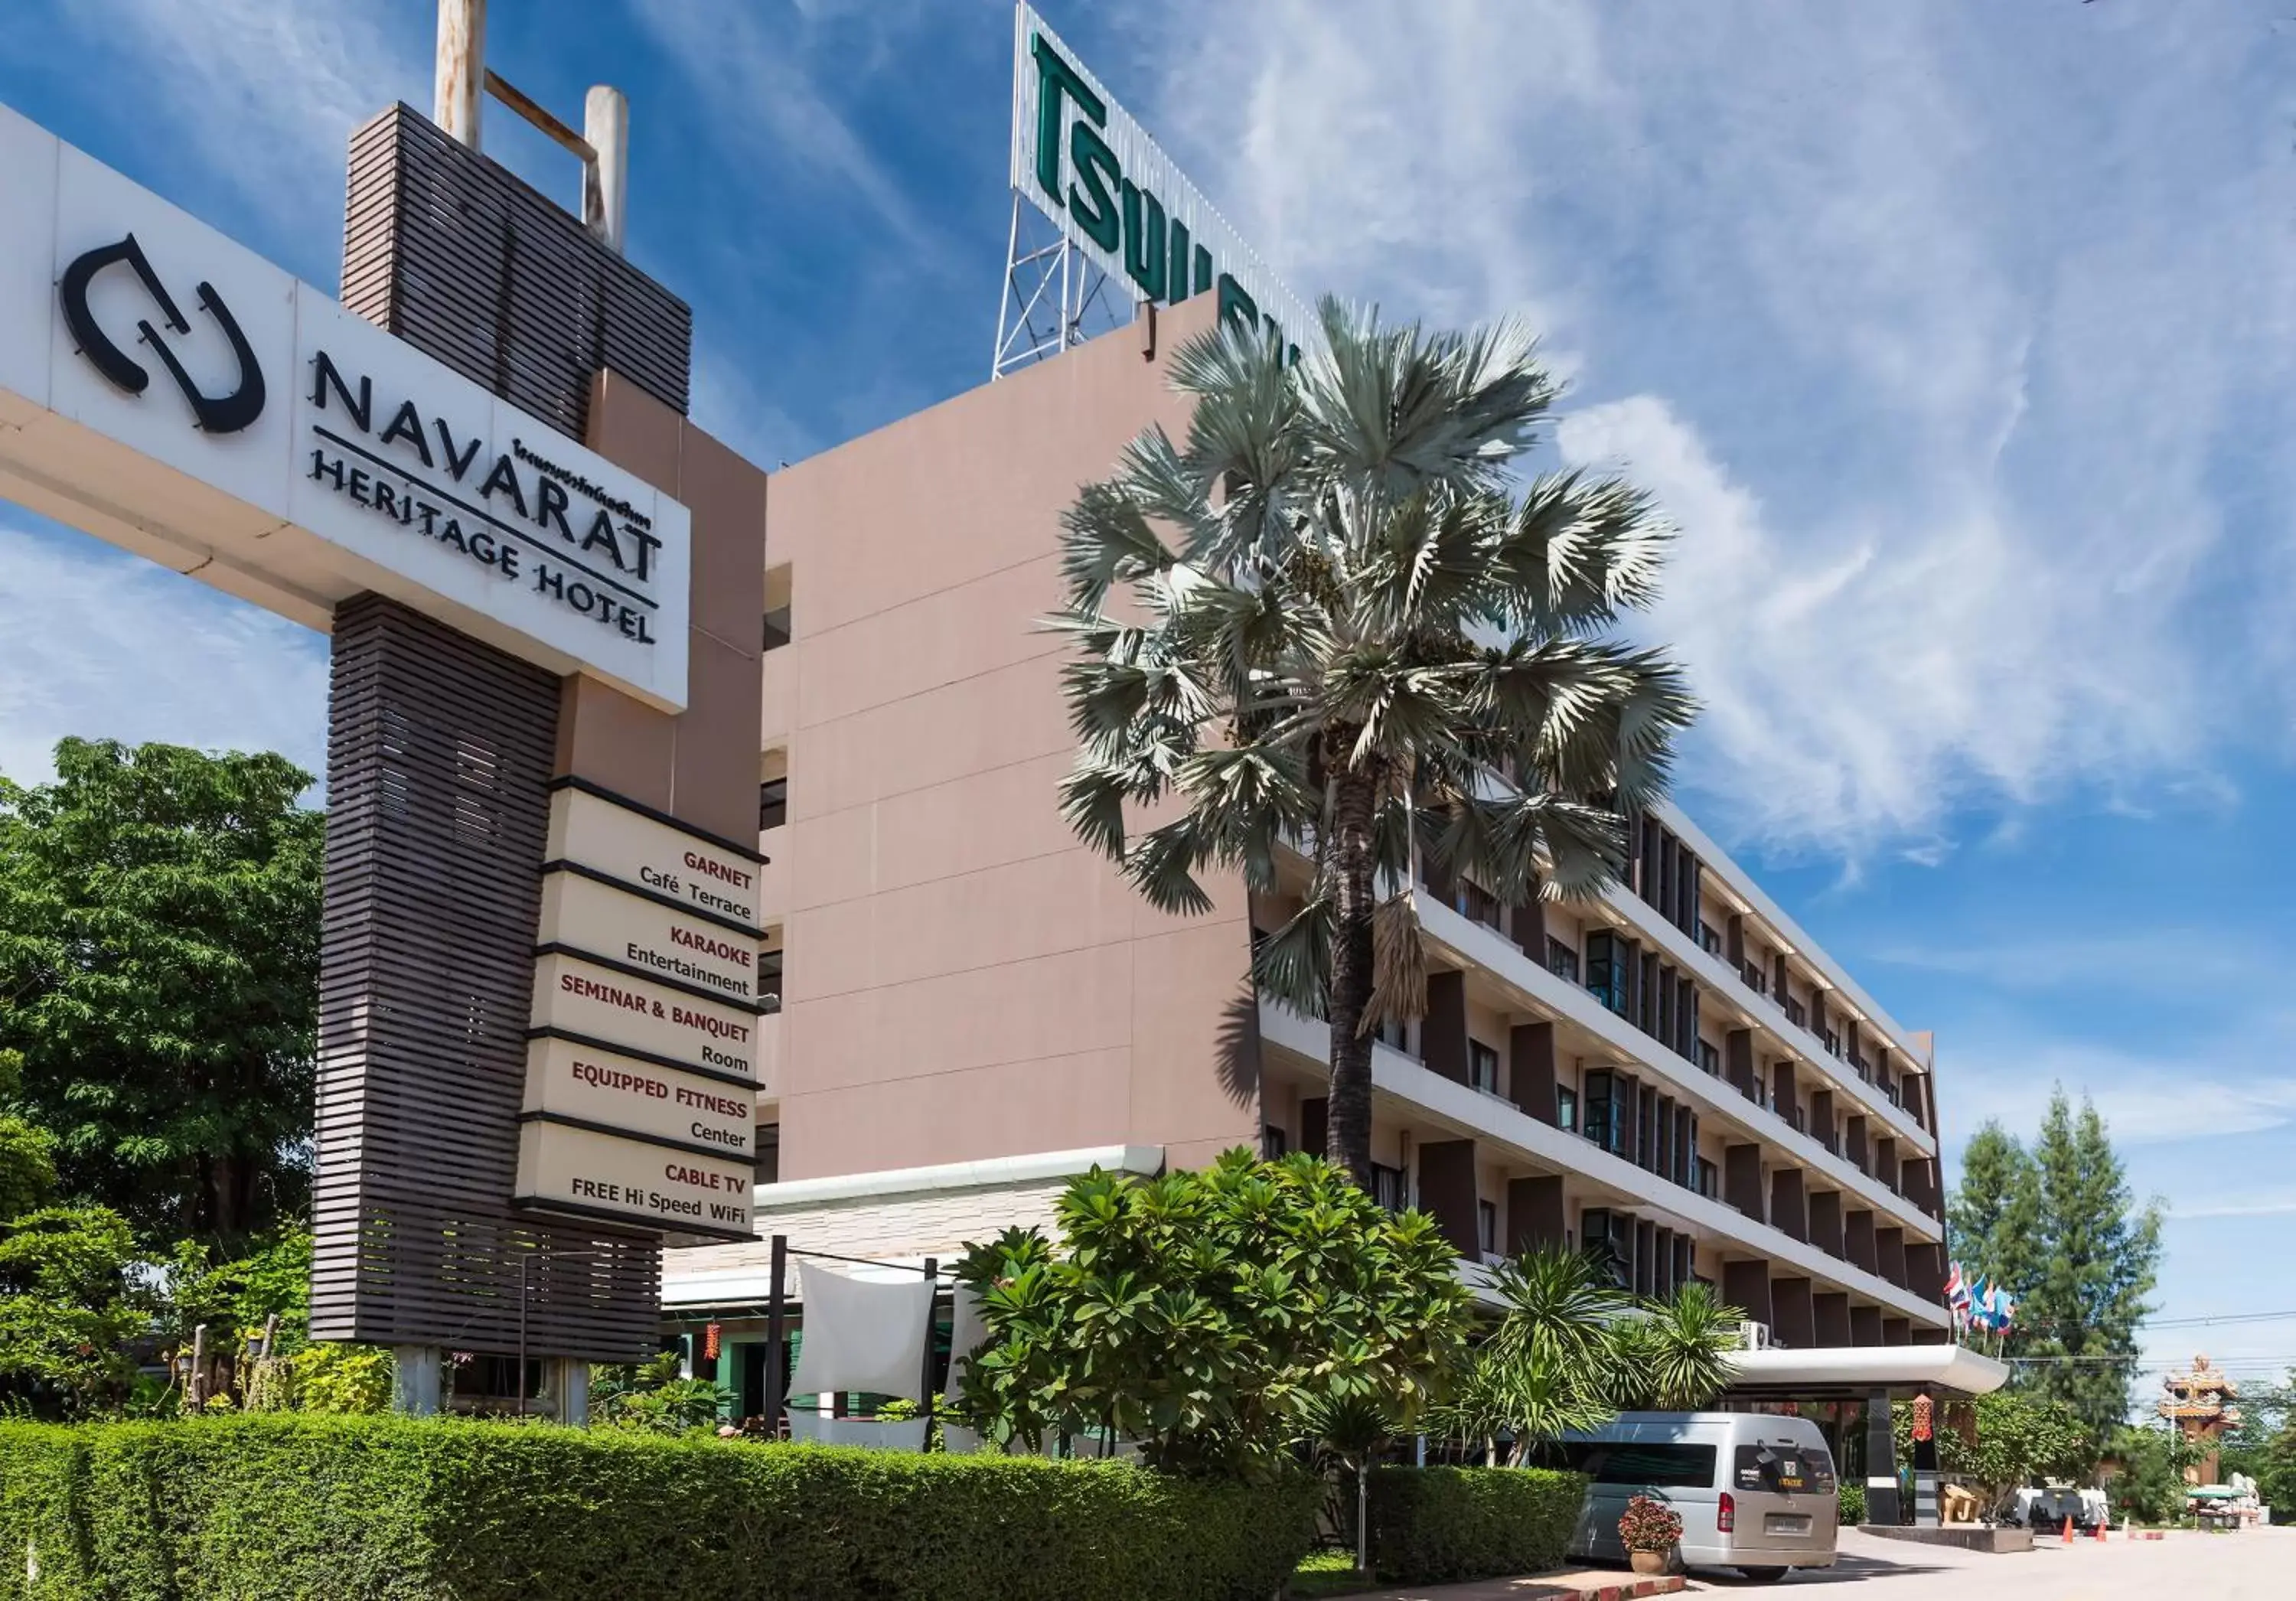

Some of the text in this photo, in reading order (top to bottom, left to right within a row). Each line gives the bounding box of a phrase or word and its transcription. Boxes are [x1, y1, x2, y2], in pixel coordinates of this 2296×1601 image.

[315, 350, 662, 582] NAVARAT
[314, 448, 656, 644] HERITAGE HOTEL
[641, 866, 751, 919] Café Terrace
[684, 852, 752, 890] GARNET
[627, 943, 749, 996] Entertainment
[670, 926, 751, 967] KARAOKE
[561, 974, 749, 1043] SEMINAR & BANQUET
[702, 1045, 748, 1072] Room
[572, 1061, 748, 1118] EQUIPPED FITNESS
[691, 1122, 746, 1147] Center
[572, 1178, 745, 1224] FREE Hi Speed WiFi
[665, 1164, 745, 1195] CABLE TV
